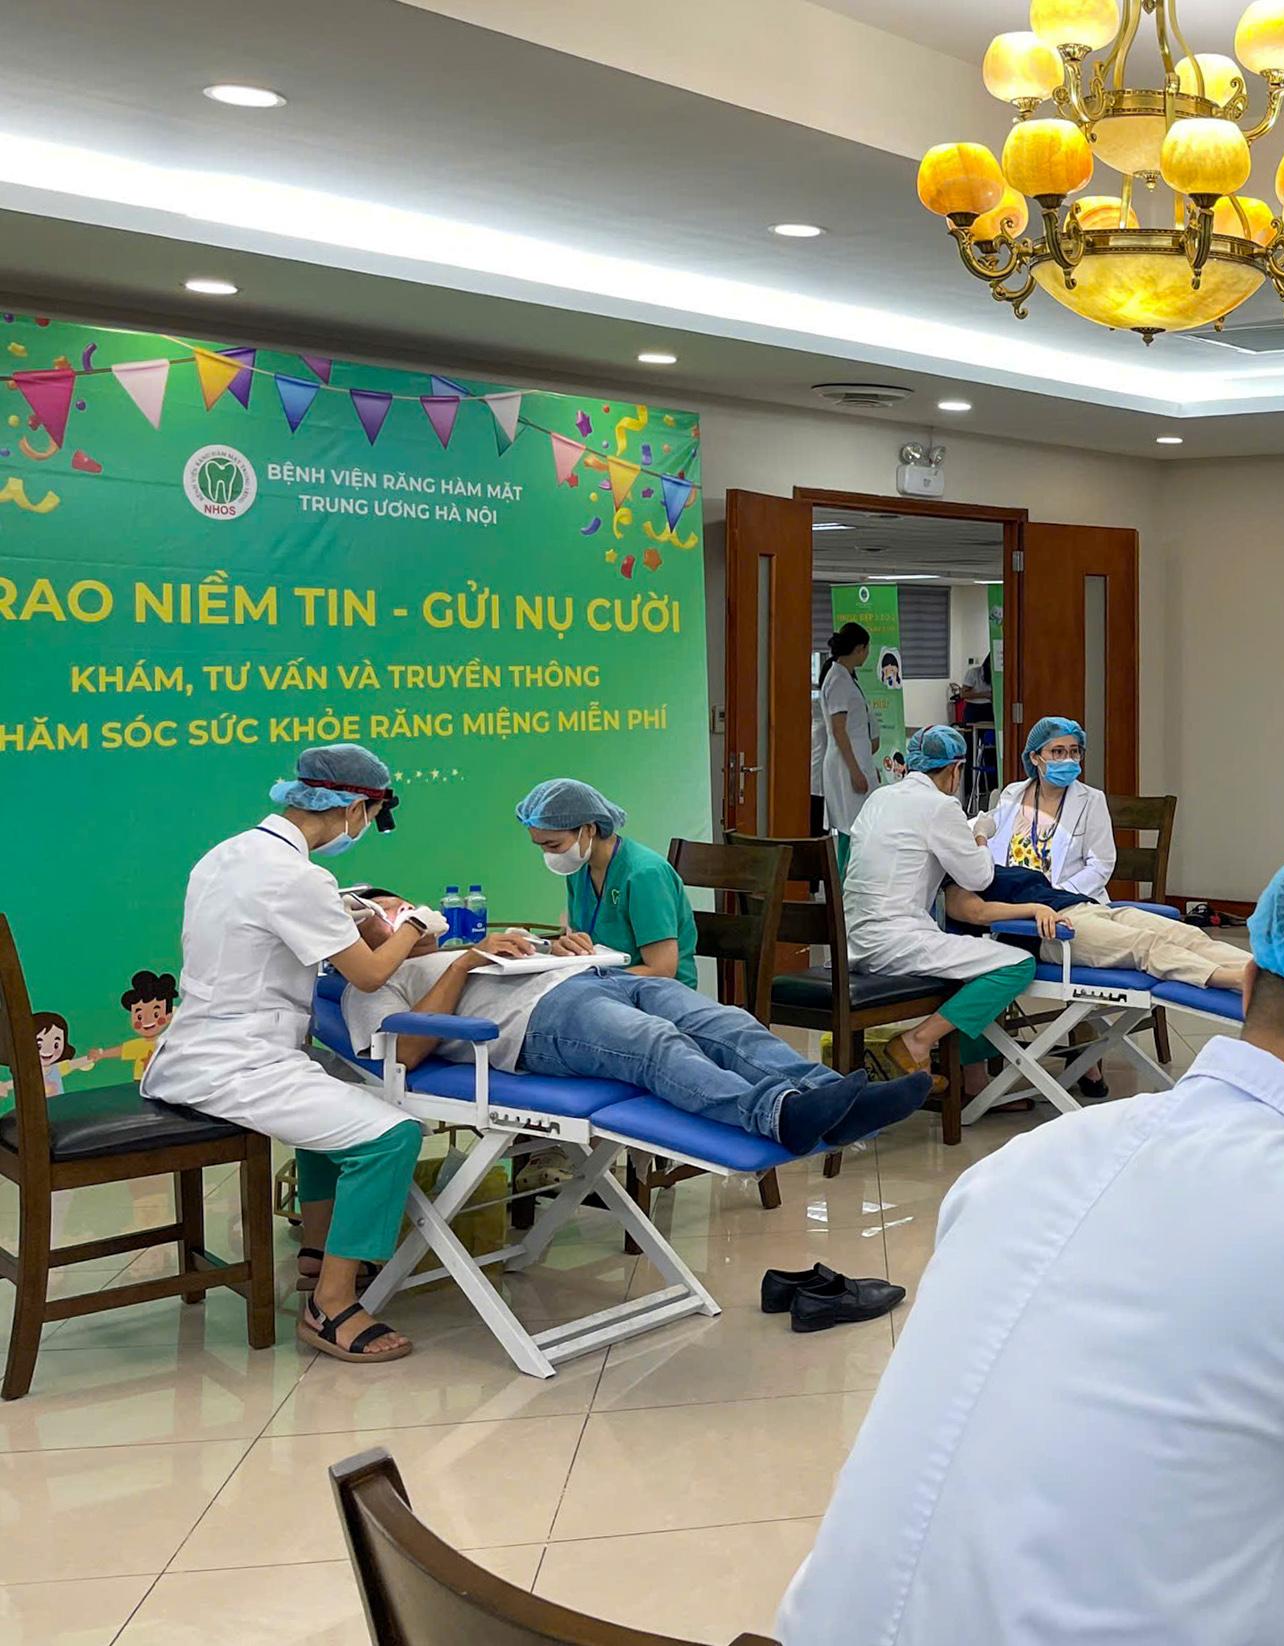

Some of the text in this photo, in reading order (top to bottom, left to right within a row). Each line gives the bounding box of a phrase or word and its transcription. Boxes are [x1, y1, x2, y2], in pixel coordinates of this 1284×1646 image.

[267, 461, 325, 485] BỆNH
[331, 467, 377, 490] VIỆN
[383, 471, 436, 493] RĂNG
[441, 477, 482, 497] HÀM
[487, 481, 523, 503] MẶT
[204, 505, 236, 515] NHOS
[299, 495, 497, 527] TRUNG ƯƠNG HÀ NỘI
[0, 570, 680, 640] RAO NIỀM TIN - GỬI NỤ CƯỜI
[71, 657, 600, 696] KHÁM, TƯ VẤN VÀ TRUYỀN THÔNG
[0, 701, 667, 752] HĂM SÓC SỨC KHỎE RĂNG MIỆNG MIỄN PHÍ
